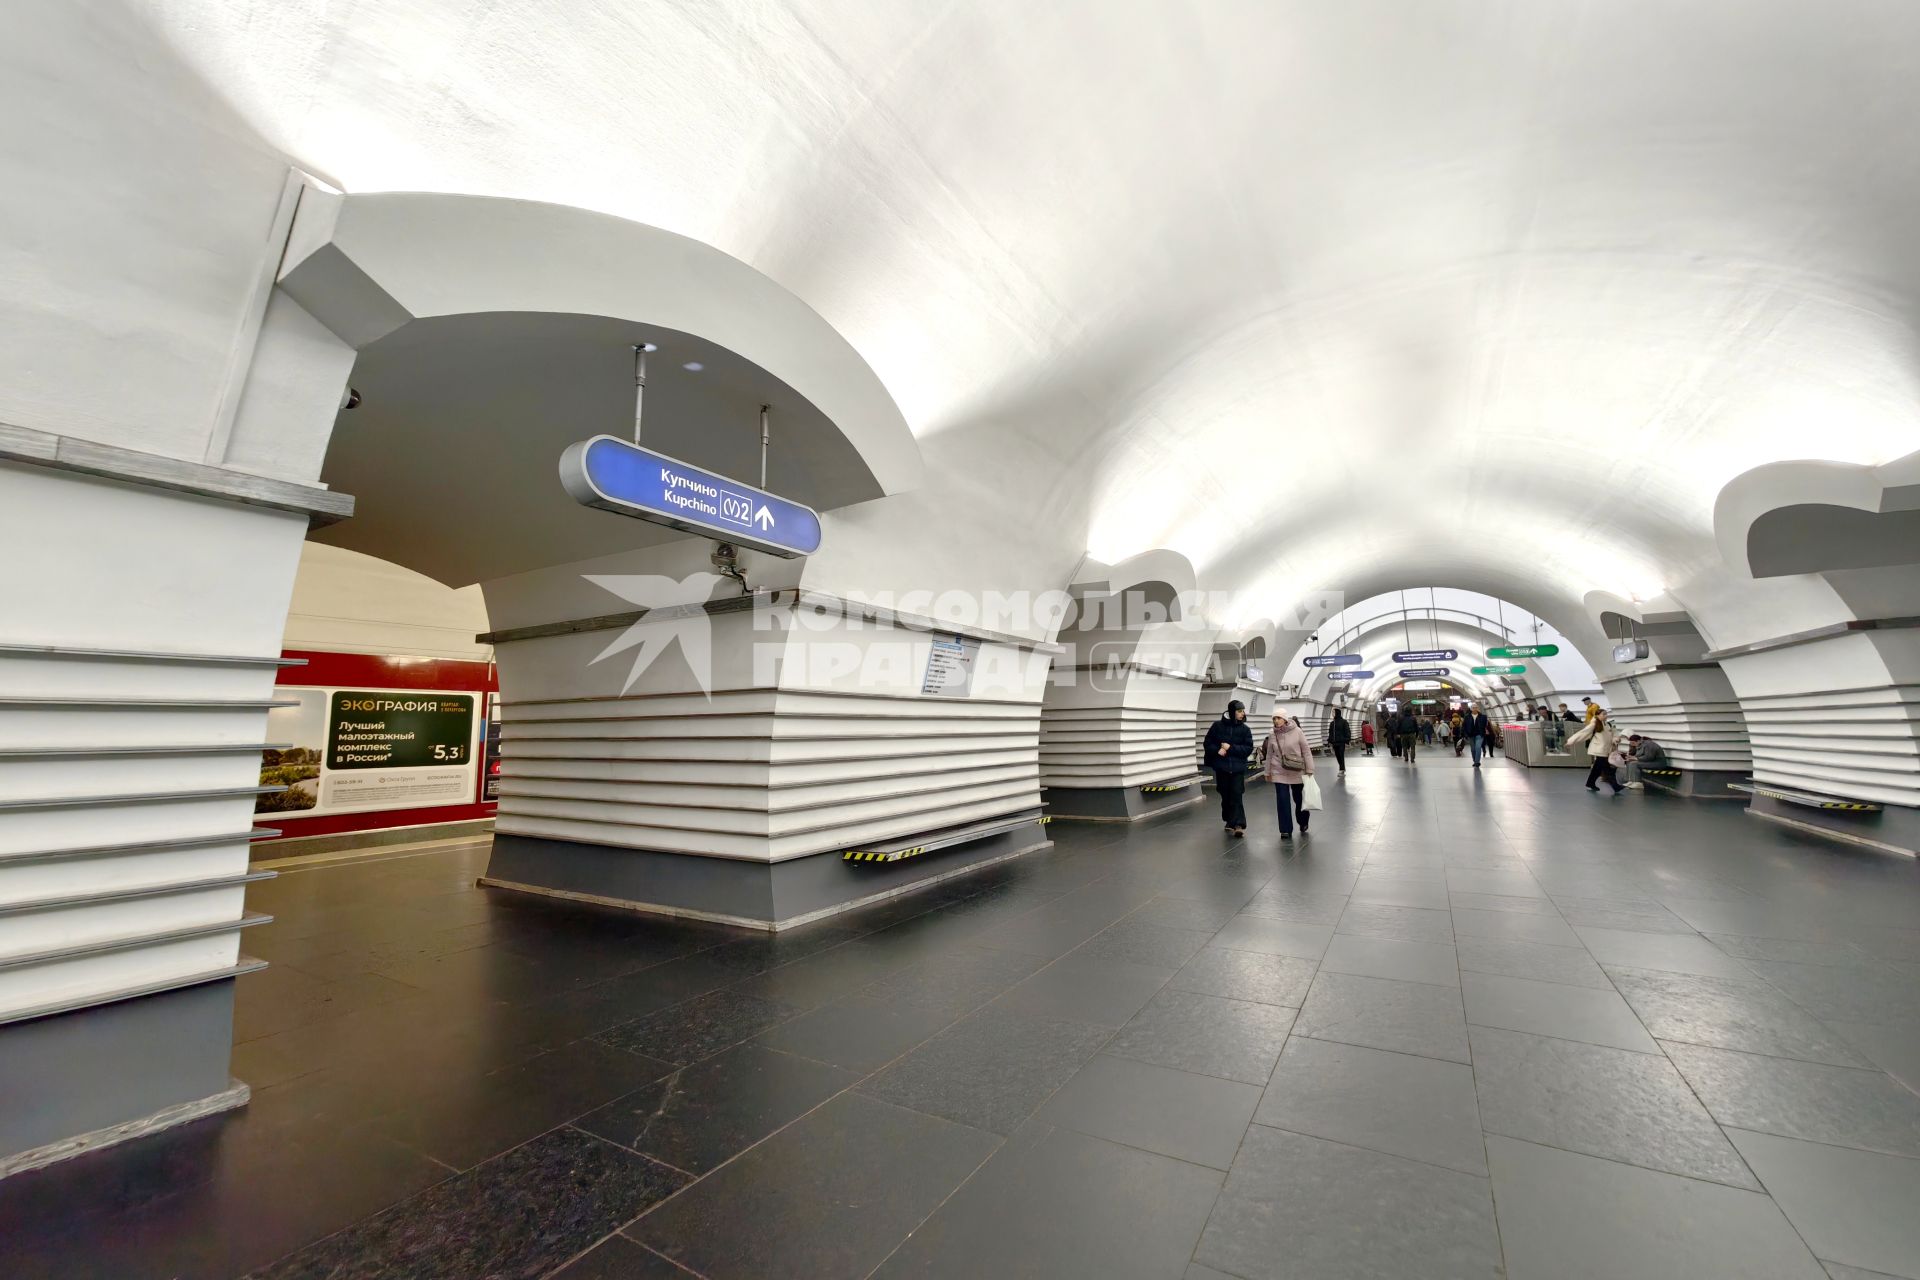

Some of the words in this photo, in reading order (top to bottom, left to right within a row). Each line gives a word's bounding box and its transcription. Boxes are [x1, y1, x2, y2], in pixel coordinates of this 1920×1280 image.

[661, 468, 718, 498] Купчино
[664, 490, 718, 515] Kupchino
[340, 699, 437, 712] ЭКОГРАФИЯ
[338, 721, 385, 732] Лучший
[337, 732, 415, 741] малоэтажный
[336, 743, 392, 752] комплекс
[434, 744, 459, 761] 5,3
